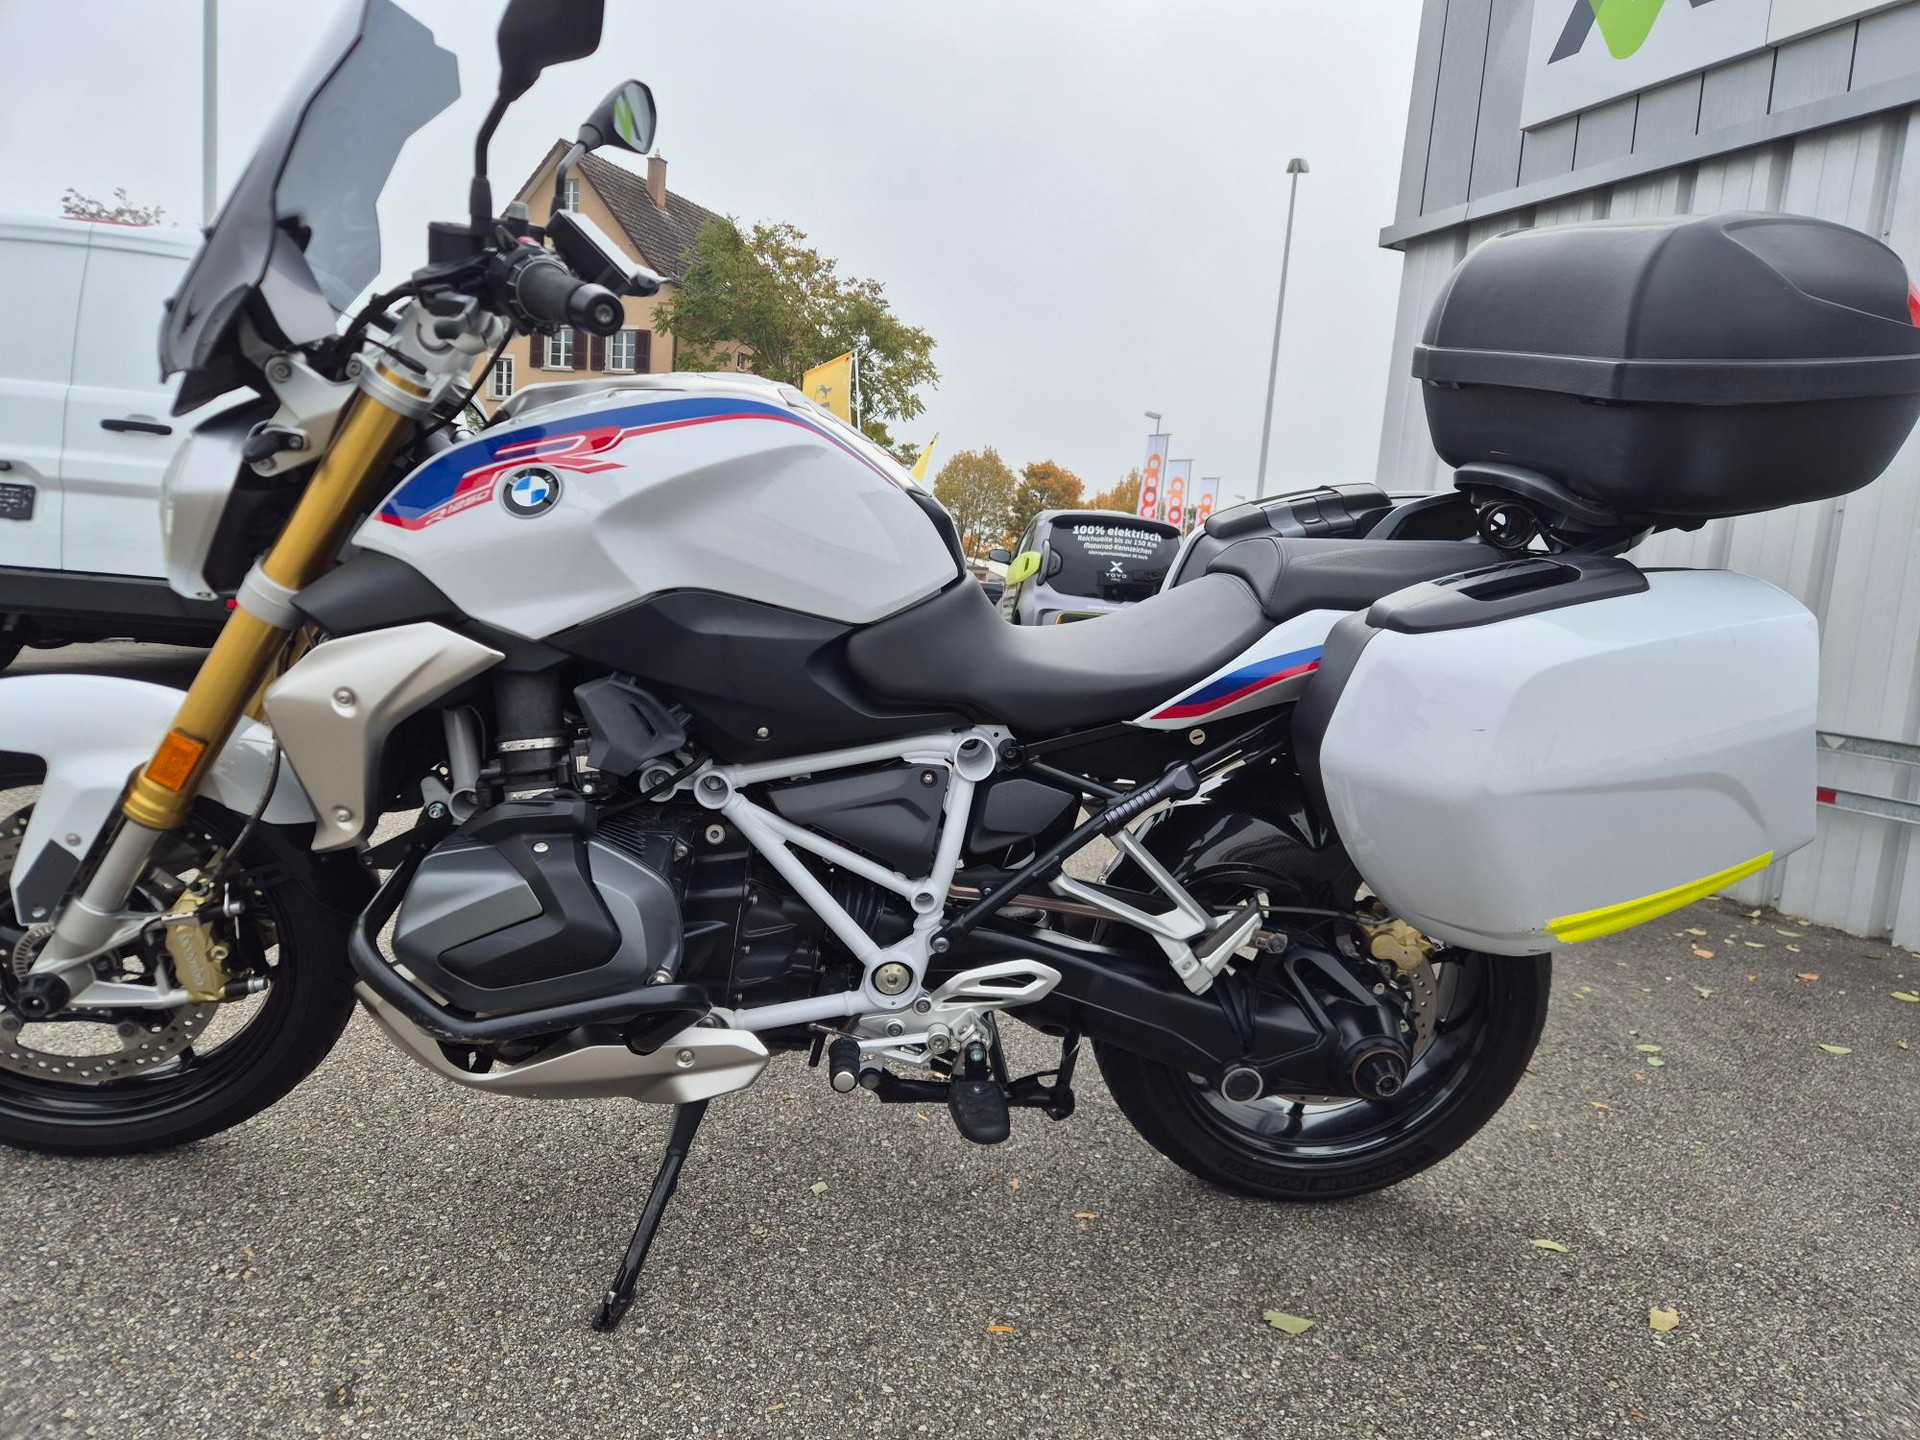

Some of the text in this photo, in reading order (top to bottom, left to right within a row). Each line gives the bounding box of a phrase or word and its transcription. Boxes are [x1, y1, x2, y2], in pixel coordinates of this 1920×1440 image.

[447, 490, 491, 513] 1250
[1072, 525, 1162, 542] 100% elektrisch
[1077, 535, 1113, 543] Reichweite
[1114, 536, 1123, 544] bis
[1134, 539, 1146, 547] 150
[1260, 1172, 1302, 1191] ROAD
[1315, 1161, 1404, 1191] MICHELIN
